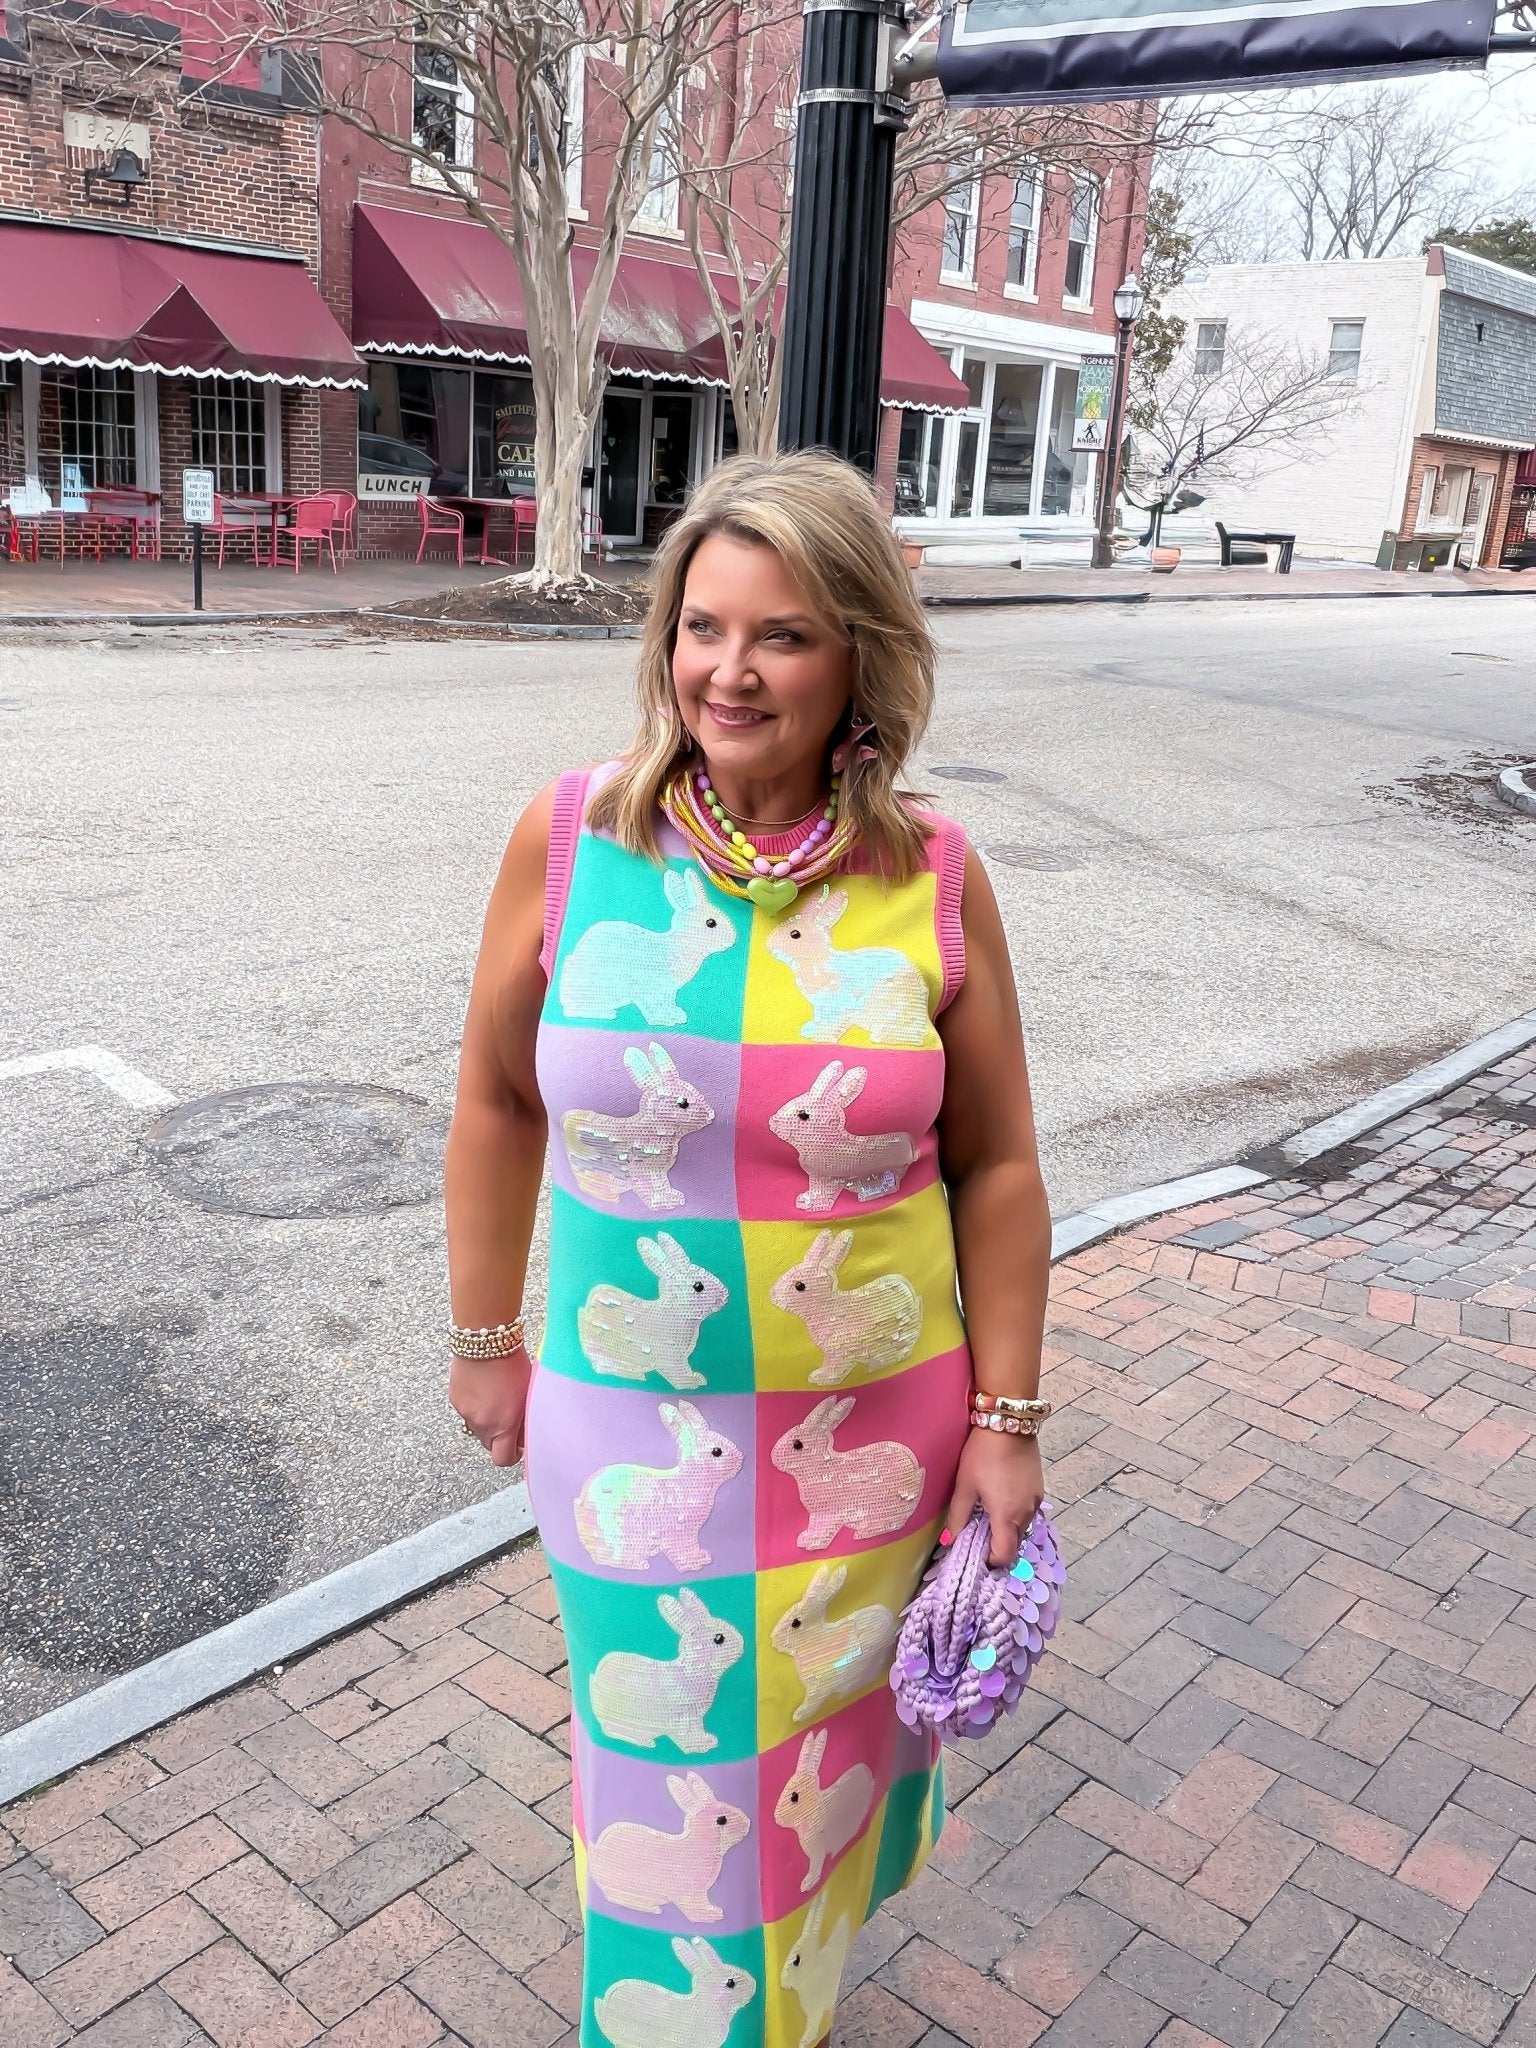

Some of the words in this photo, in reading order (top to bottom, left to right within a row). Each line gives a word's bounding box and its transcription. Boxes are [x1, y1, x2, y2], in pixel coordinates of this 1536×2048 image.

[1080, 366, 1113, 377] HAMS
[1077, 393, 1111, 405] HERT
[497, 444, 536, 463] CAF
[497, 468, 515, 477] AND
[517, 469, 536, 478] BAK
[365, 478, 423, 493] LUNCH
[187, 499, 210, 508] PARKING
[191, 509, 206, 517] ONLY
